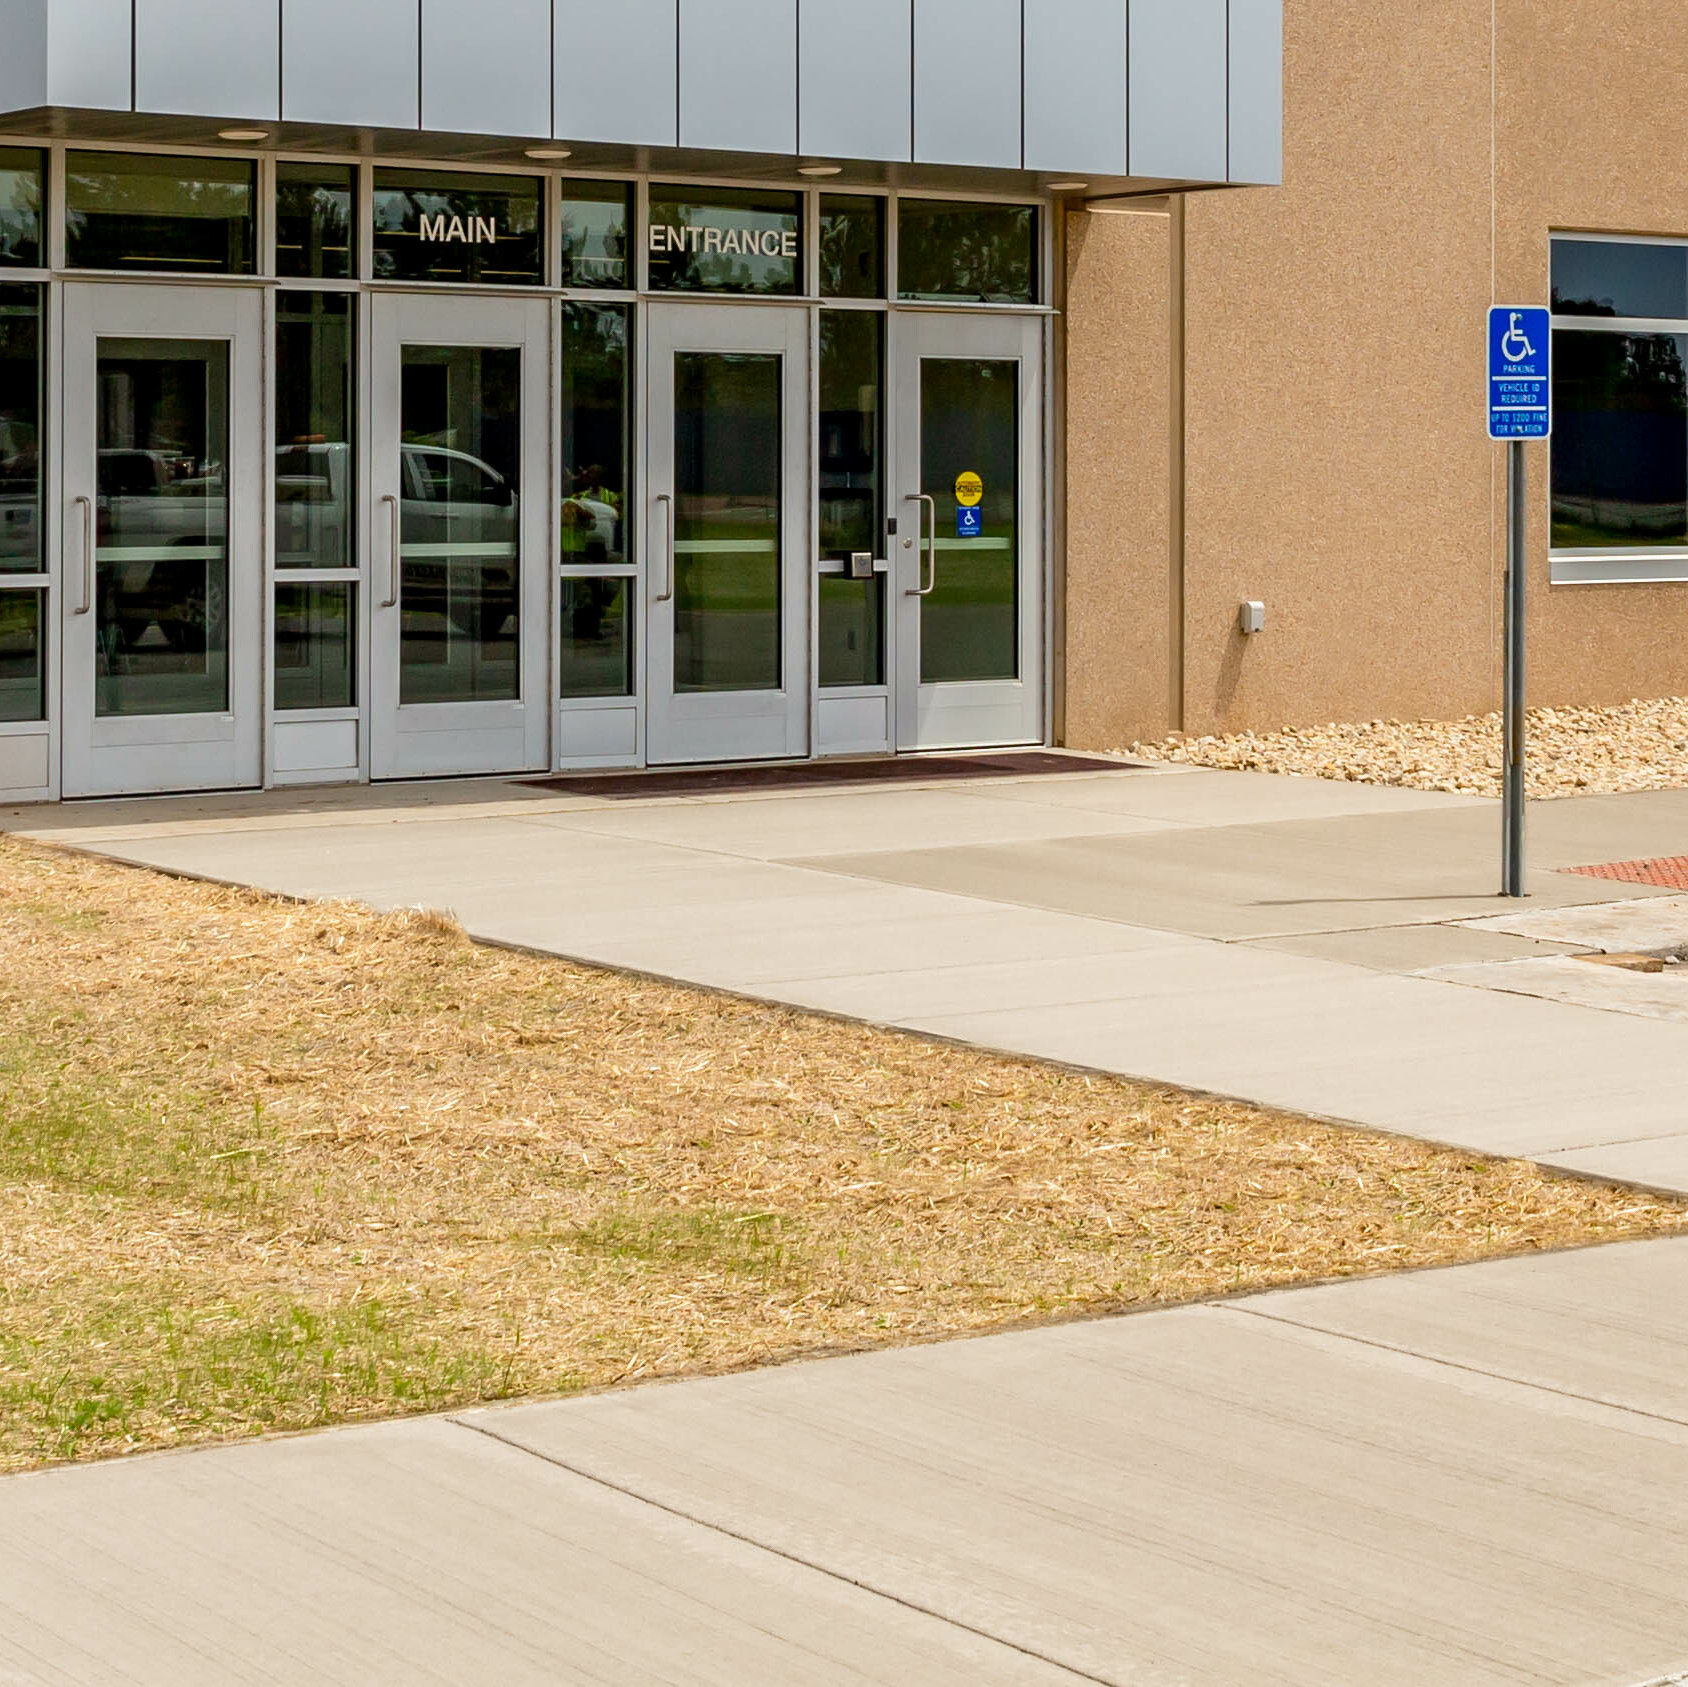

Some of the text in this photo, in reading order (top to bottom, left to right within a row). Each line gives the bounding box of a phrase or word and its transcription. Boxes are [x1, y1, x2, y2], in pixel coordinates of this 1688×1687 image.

[419, 214, 798, 258] MAIN ENTRANCE
[1502, 364, 1536, 374] PARKING
[1498, 383, 1540, 393] VEHICLE ID
[1500, 394, 1538, 404] REQUIRED
[1510, 424, 1543, 434] VILATION
